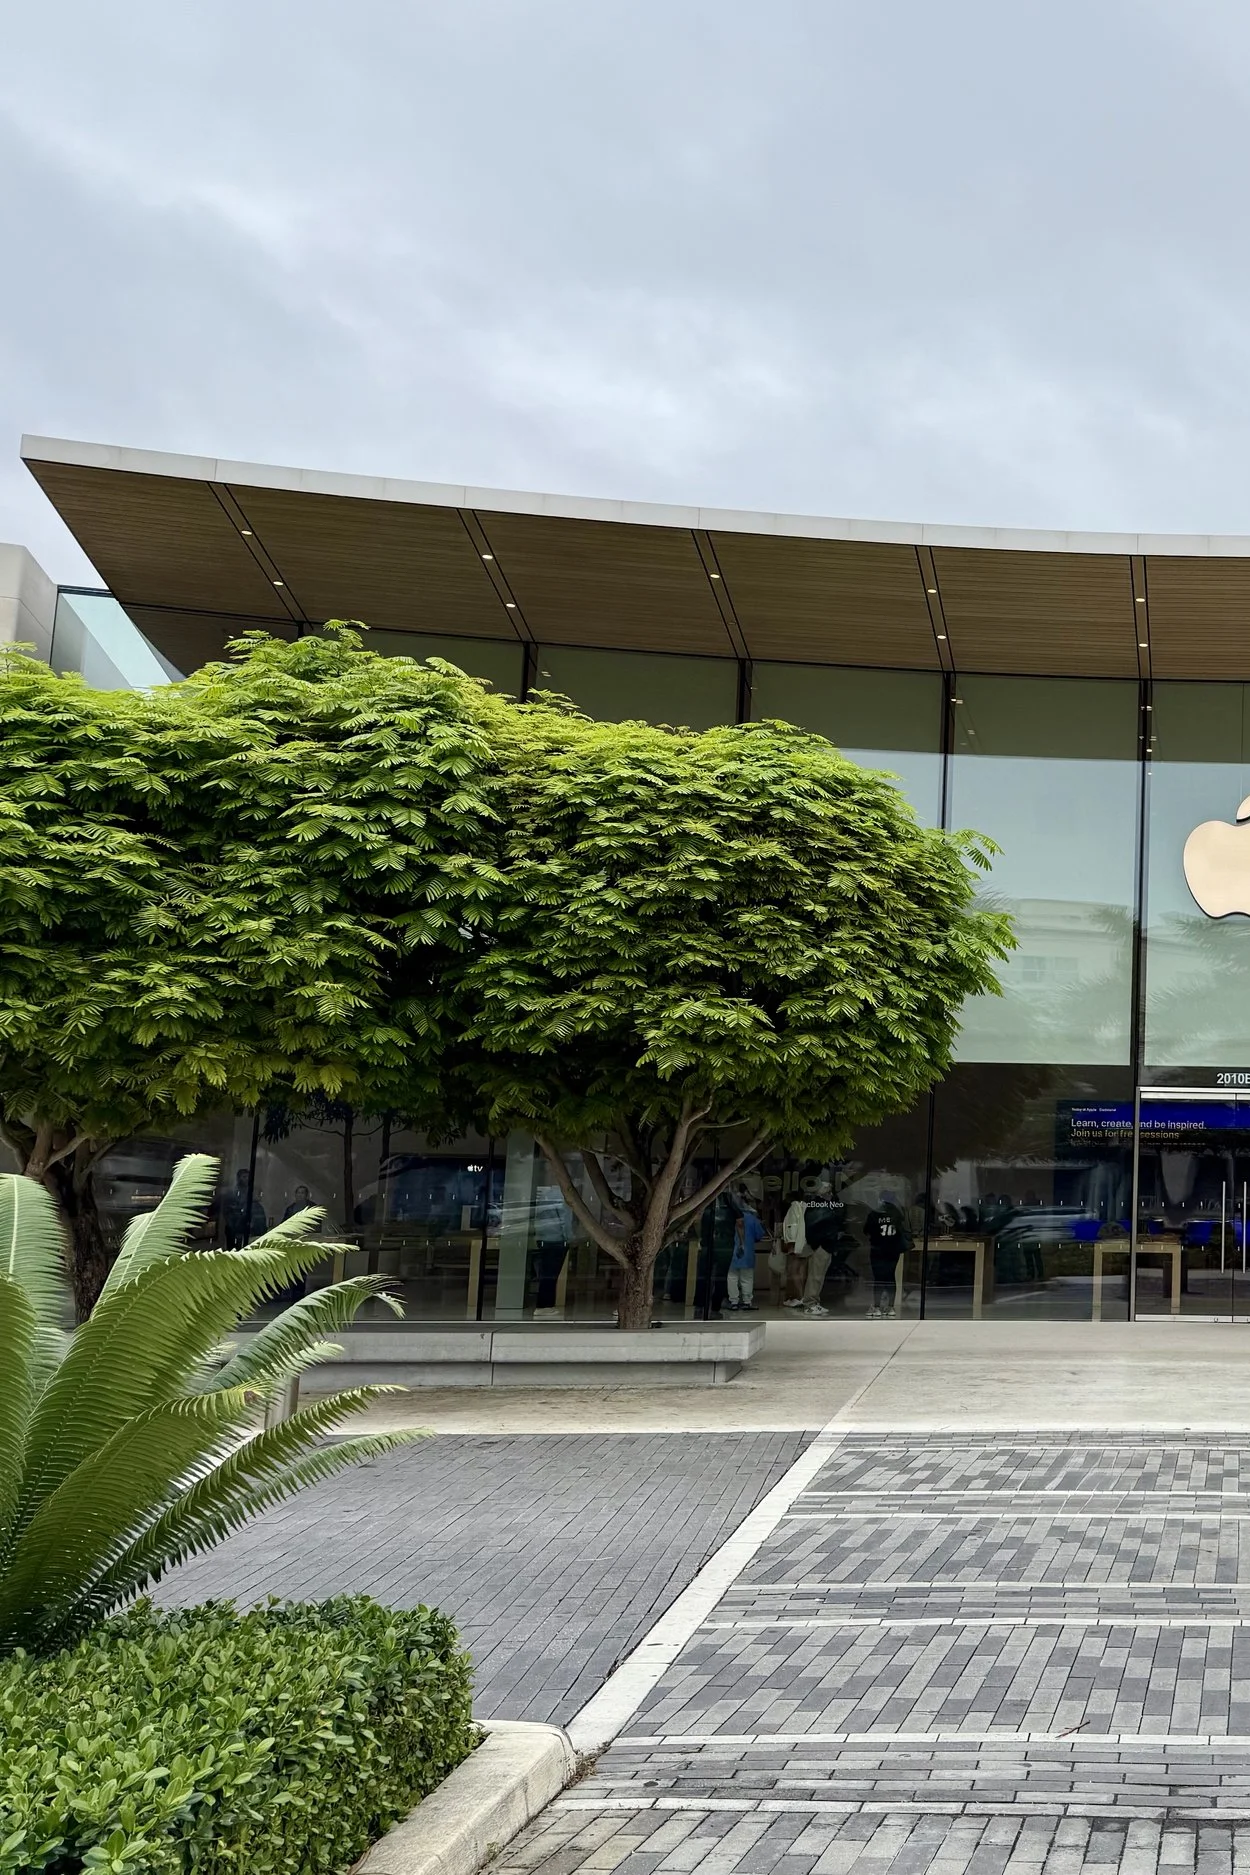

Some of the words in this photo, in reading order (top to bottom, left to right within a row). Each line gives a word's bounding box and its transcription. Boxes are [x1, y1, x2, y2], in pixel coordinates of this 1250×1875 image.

[1071, 1118, 1099, 1129] Learn,
[1101, 1119, 1134, 1130] create,
[1139, 1120, 1152, 1129] nd
[1154, 1120, 1166, 1129] be
[1167, 1120, 1207, 1131] inspired.
[1070, 1128, 1091, 1138] Join
[1092, 1130, 1103, 1138] us
[1120, 1129, 1134, 1138] fre
[1139, 1130, 1180, 1140] sessions
[829, 1200, 844, 1208] Neo
